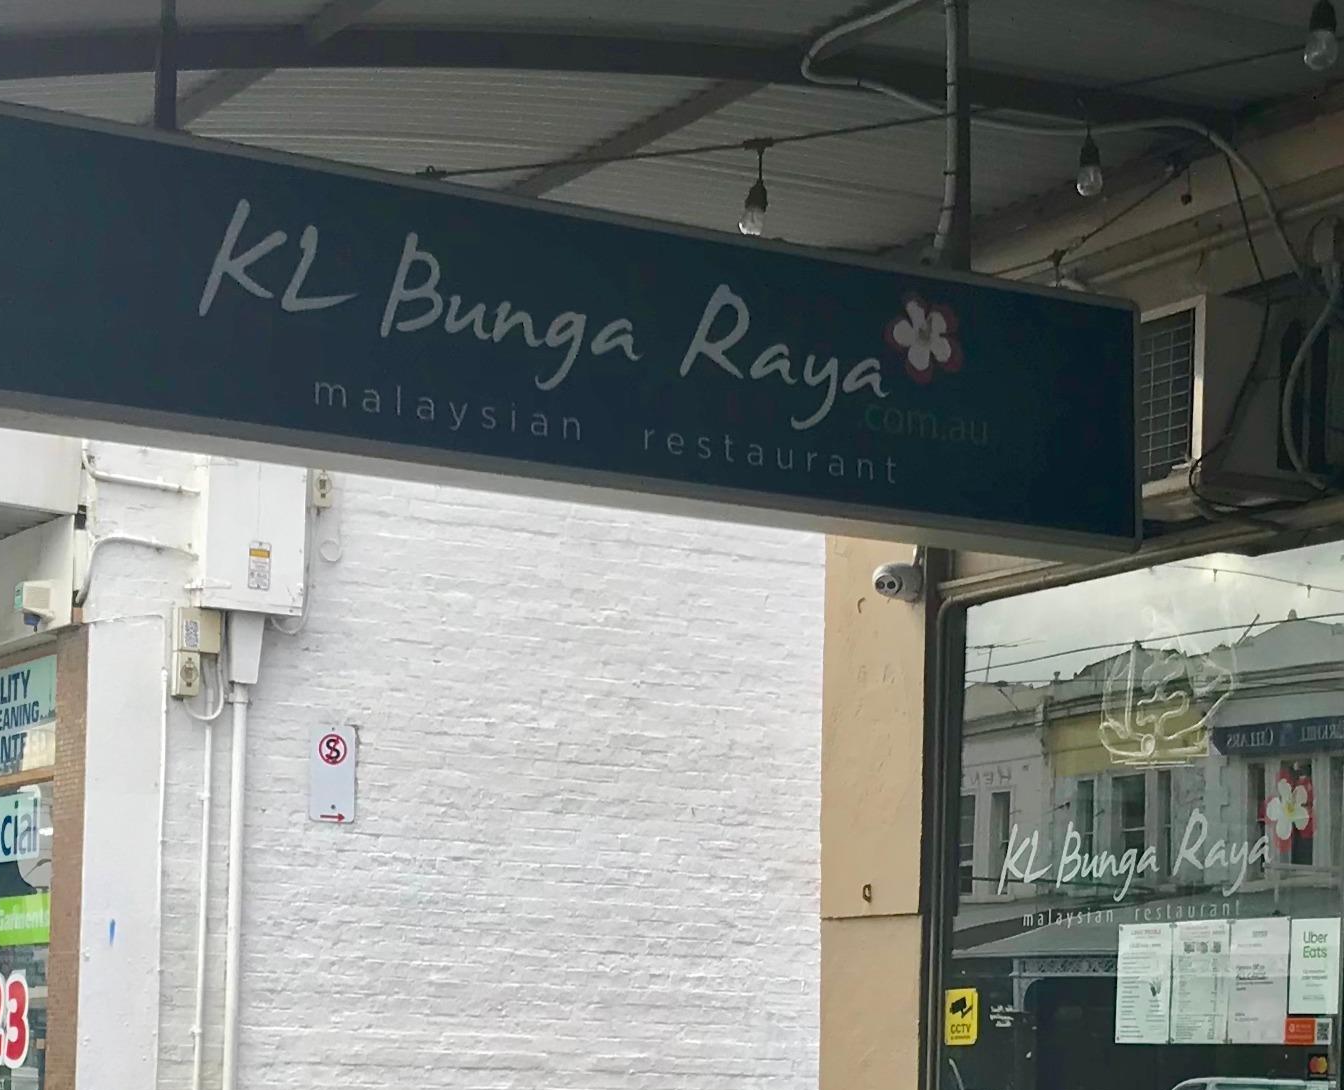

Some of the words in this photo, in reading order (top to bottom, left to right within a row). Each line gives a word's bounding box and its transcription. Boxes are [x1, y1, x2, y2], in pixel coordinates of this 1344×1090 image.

[198, 199, 359, 316] KL
[380, 232, 644, 391] Bunga
[679, 284, 890, 431] Raya
[314, 380, 582, 441] malaysian
[643, 424, 897, 485] restaurant
[997, 822, 1053, 896] KL
[1056, 820, 1160, 903] Bunga
[1172, 807, 1273, 898] Raya
[1022, 907, 1115, 929] malaysian
[1134, 898, 1242, 922] restaurant
[1302, 945, 1328, 959] Eats
[1303, 930, 1329, 944] Uber
[950, 1023, 972, 1034] CCTV
